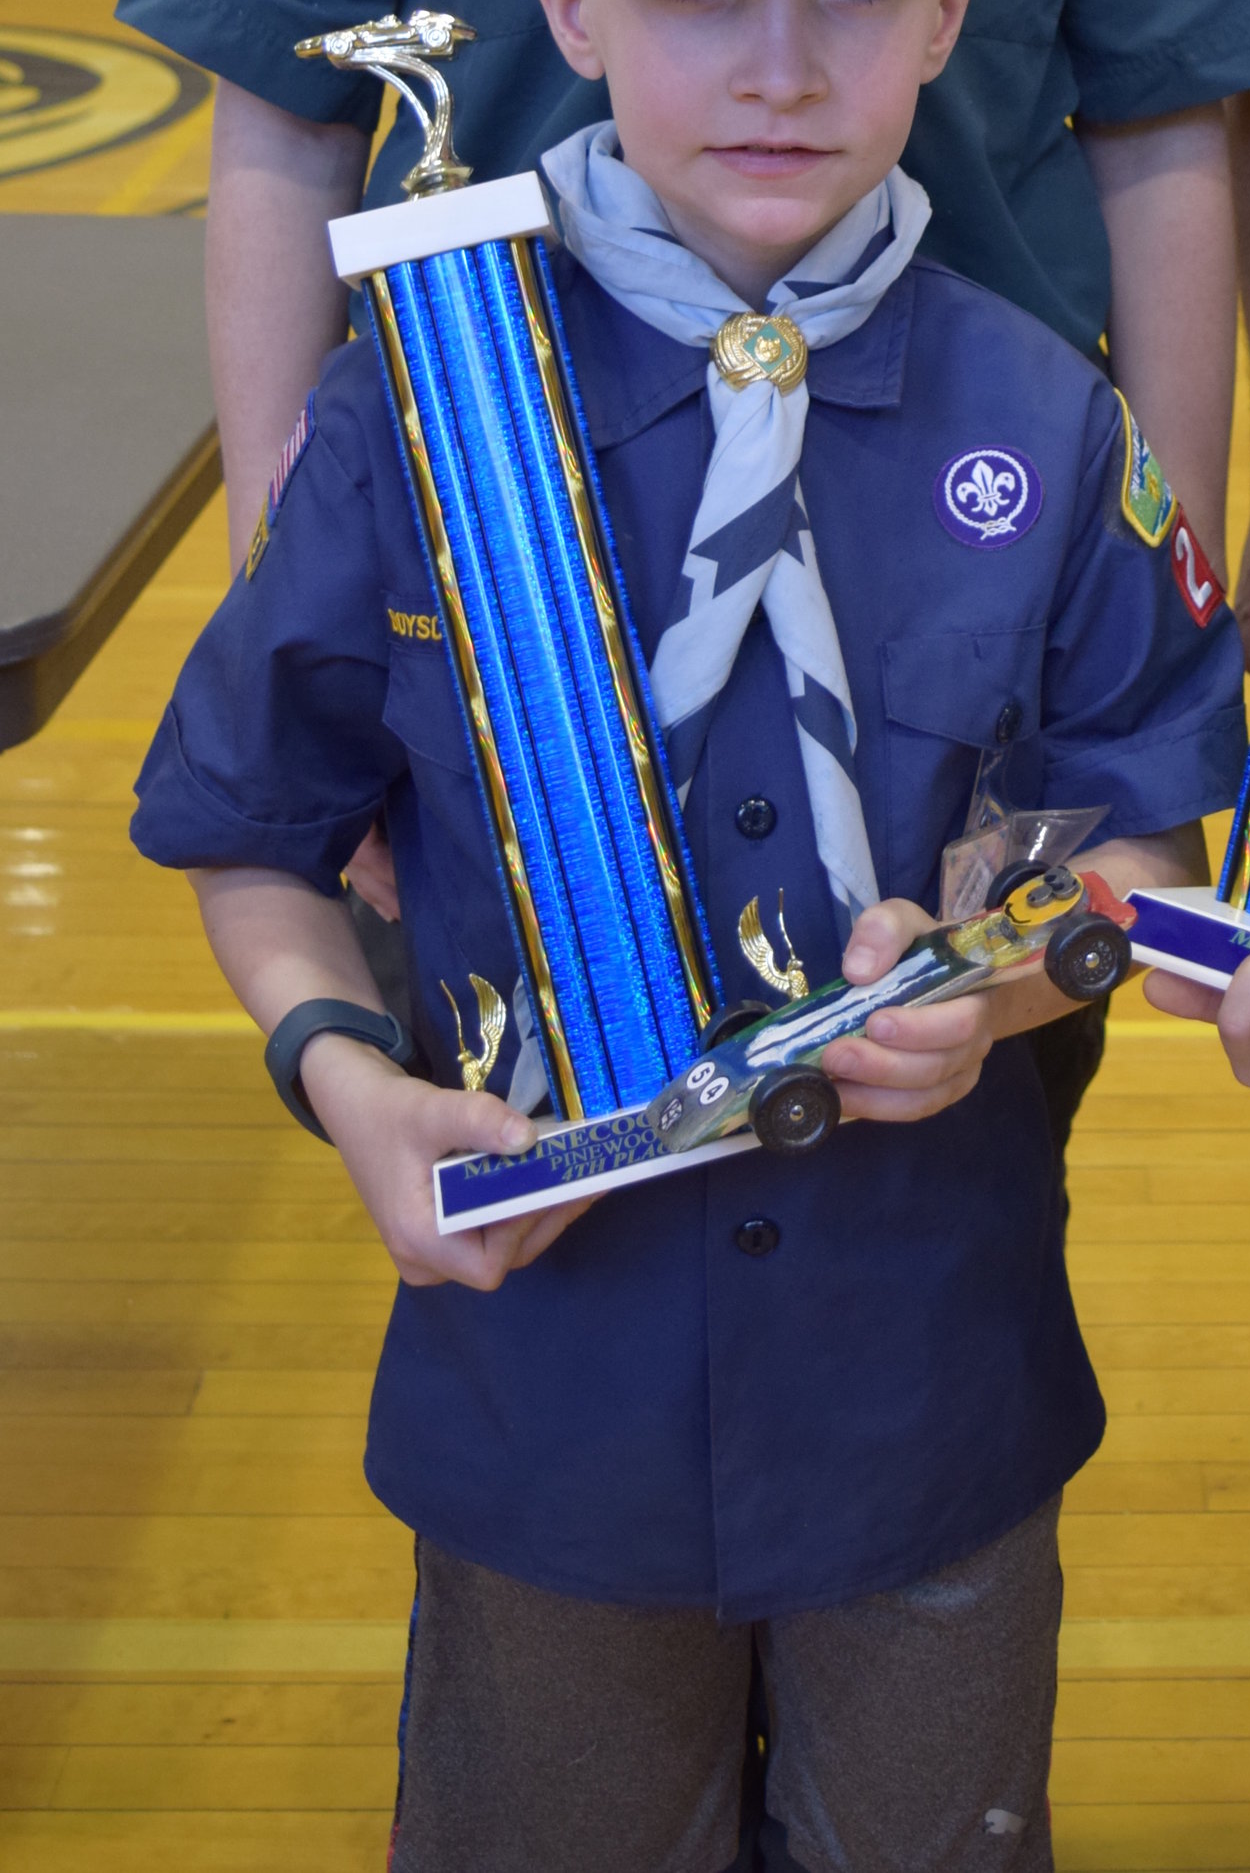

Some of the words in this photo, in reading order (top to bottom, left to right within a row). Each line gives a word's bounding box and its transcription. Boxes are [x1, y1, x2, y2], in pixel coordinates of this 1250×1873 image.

[550, 1128, 658, 1171] PINEWOO
[562, 1157, 605, 1182] 4TH
[612, 1139, 671, 1169] PLAC
